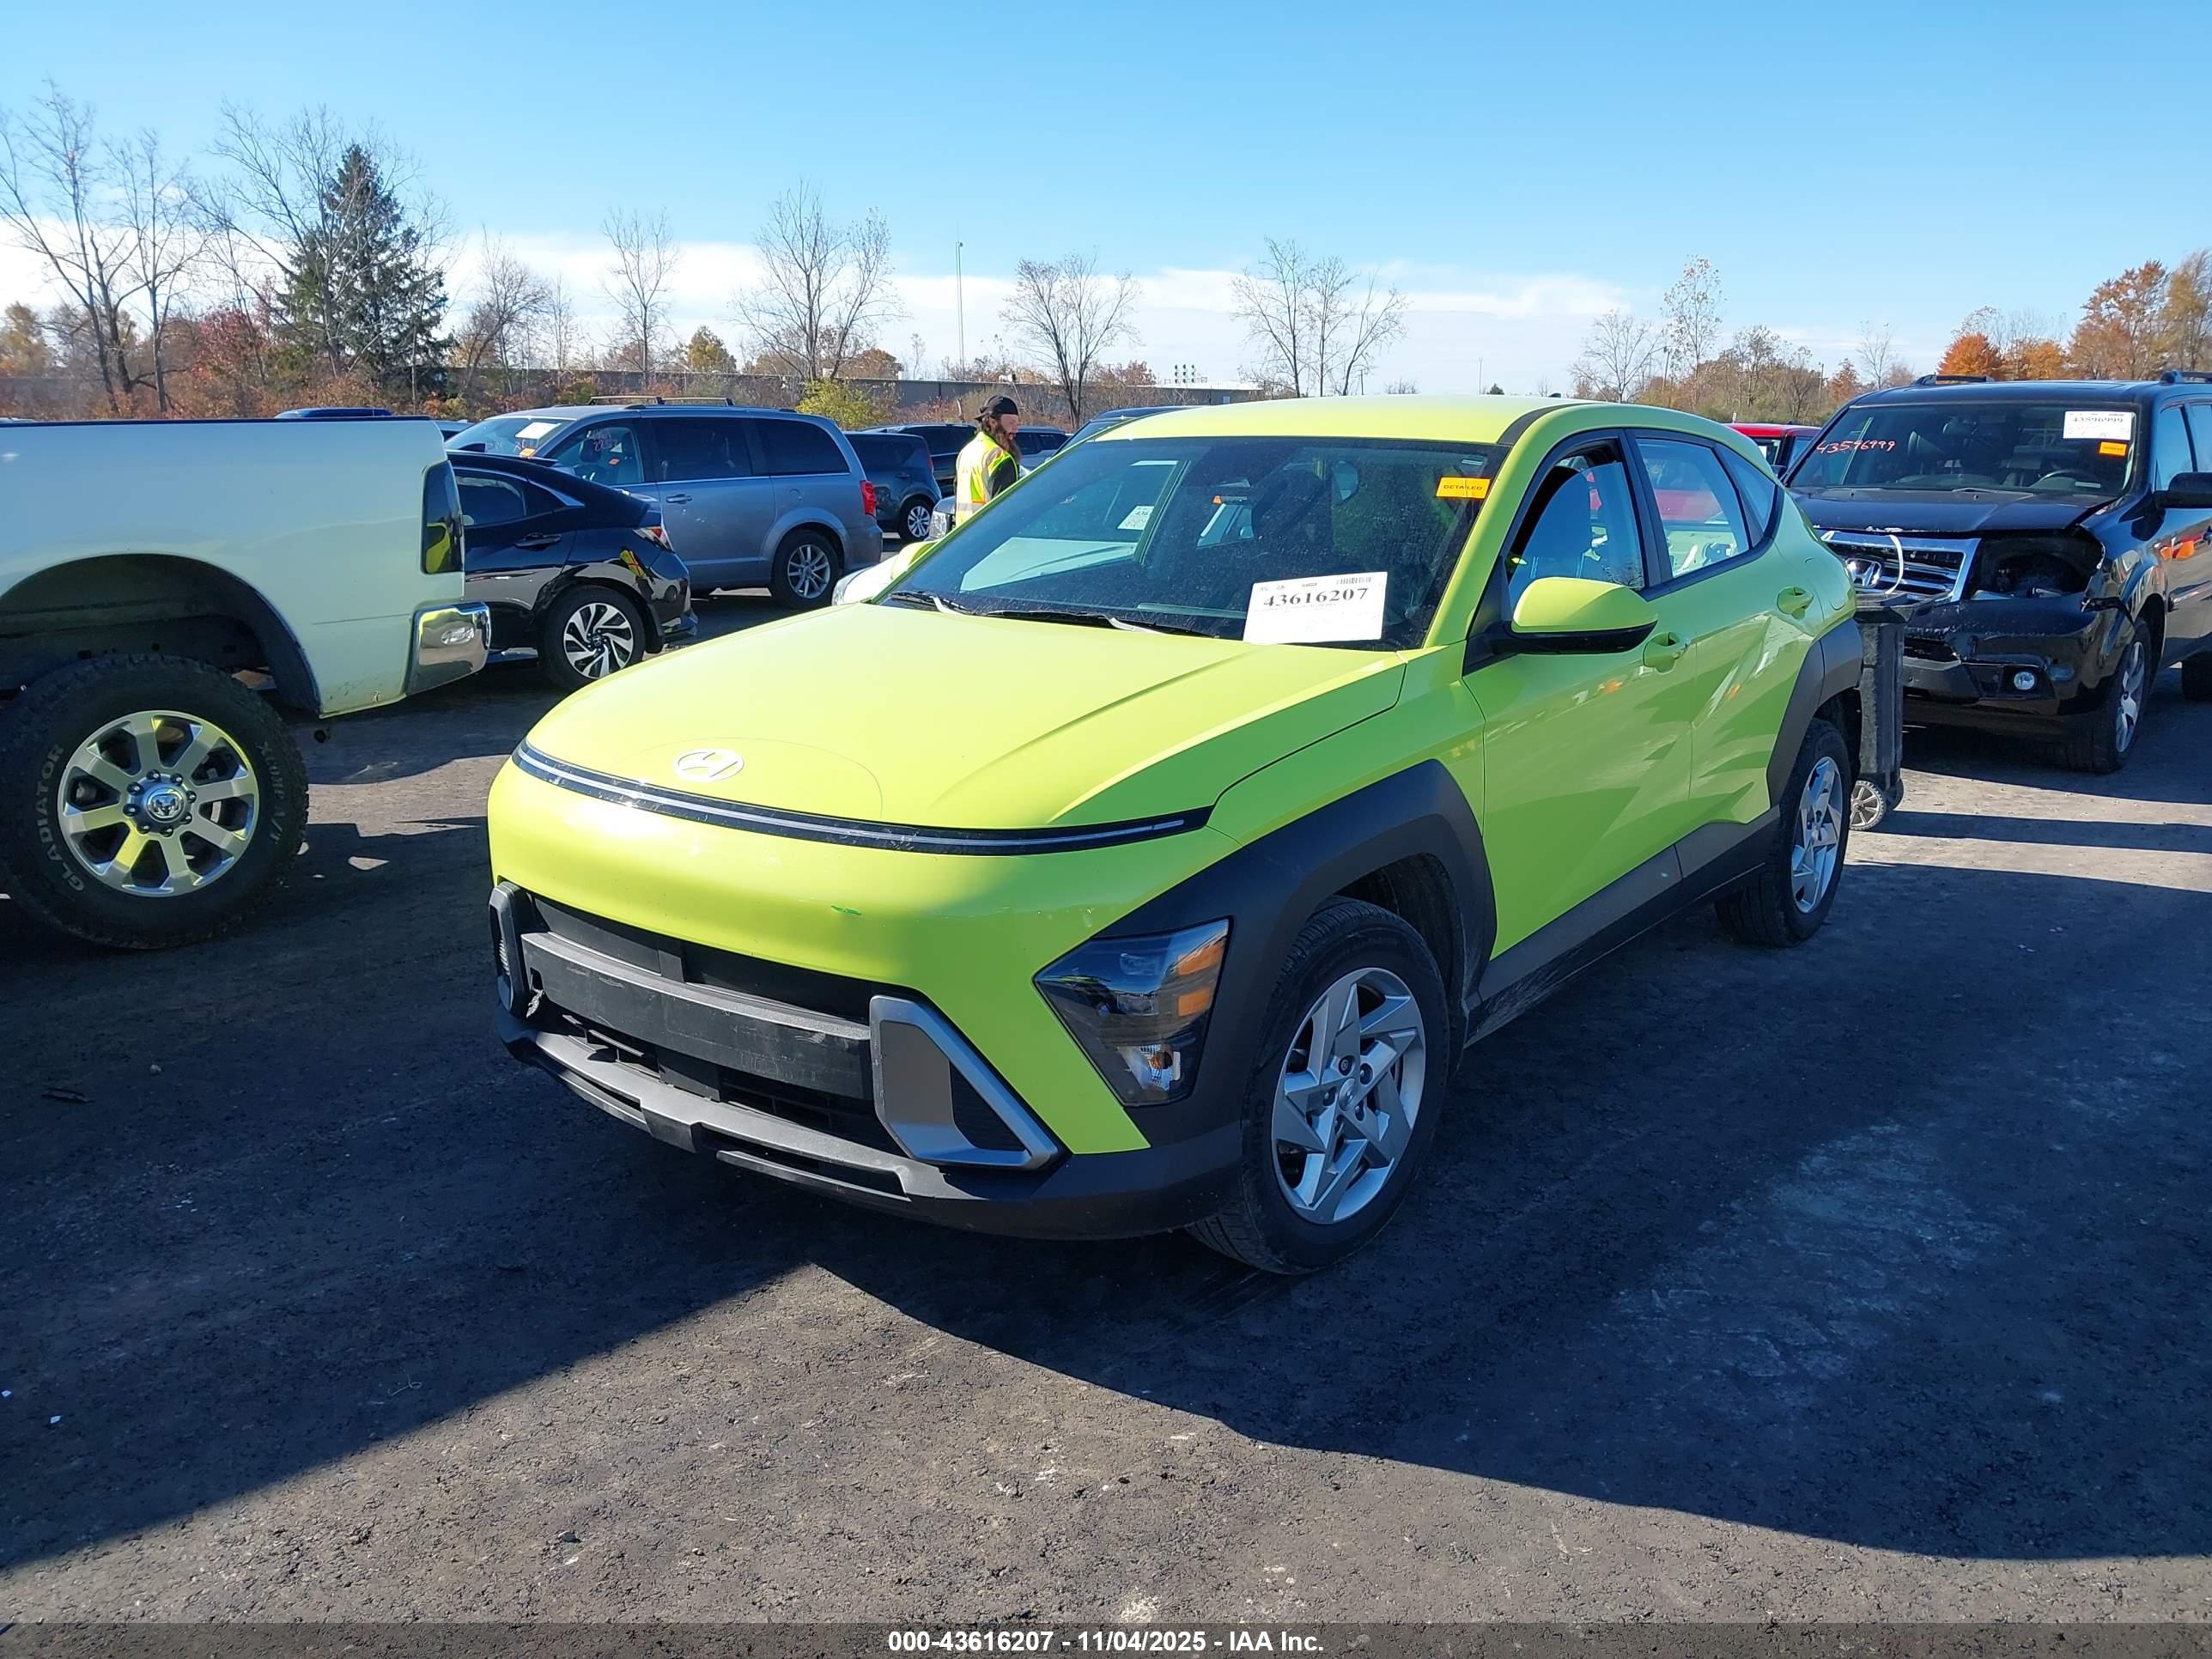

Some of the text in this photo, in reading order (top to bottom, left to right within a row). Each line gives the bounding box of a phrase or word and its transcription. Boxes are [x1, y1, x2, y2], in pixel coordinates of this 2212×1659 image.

[1816, 440, 1896, 454] 43596999
[1263, 587, 1369, 607] 43616207
[35, 744, 84, 891] GLADIATOR
